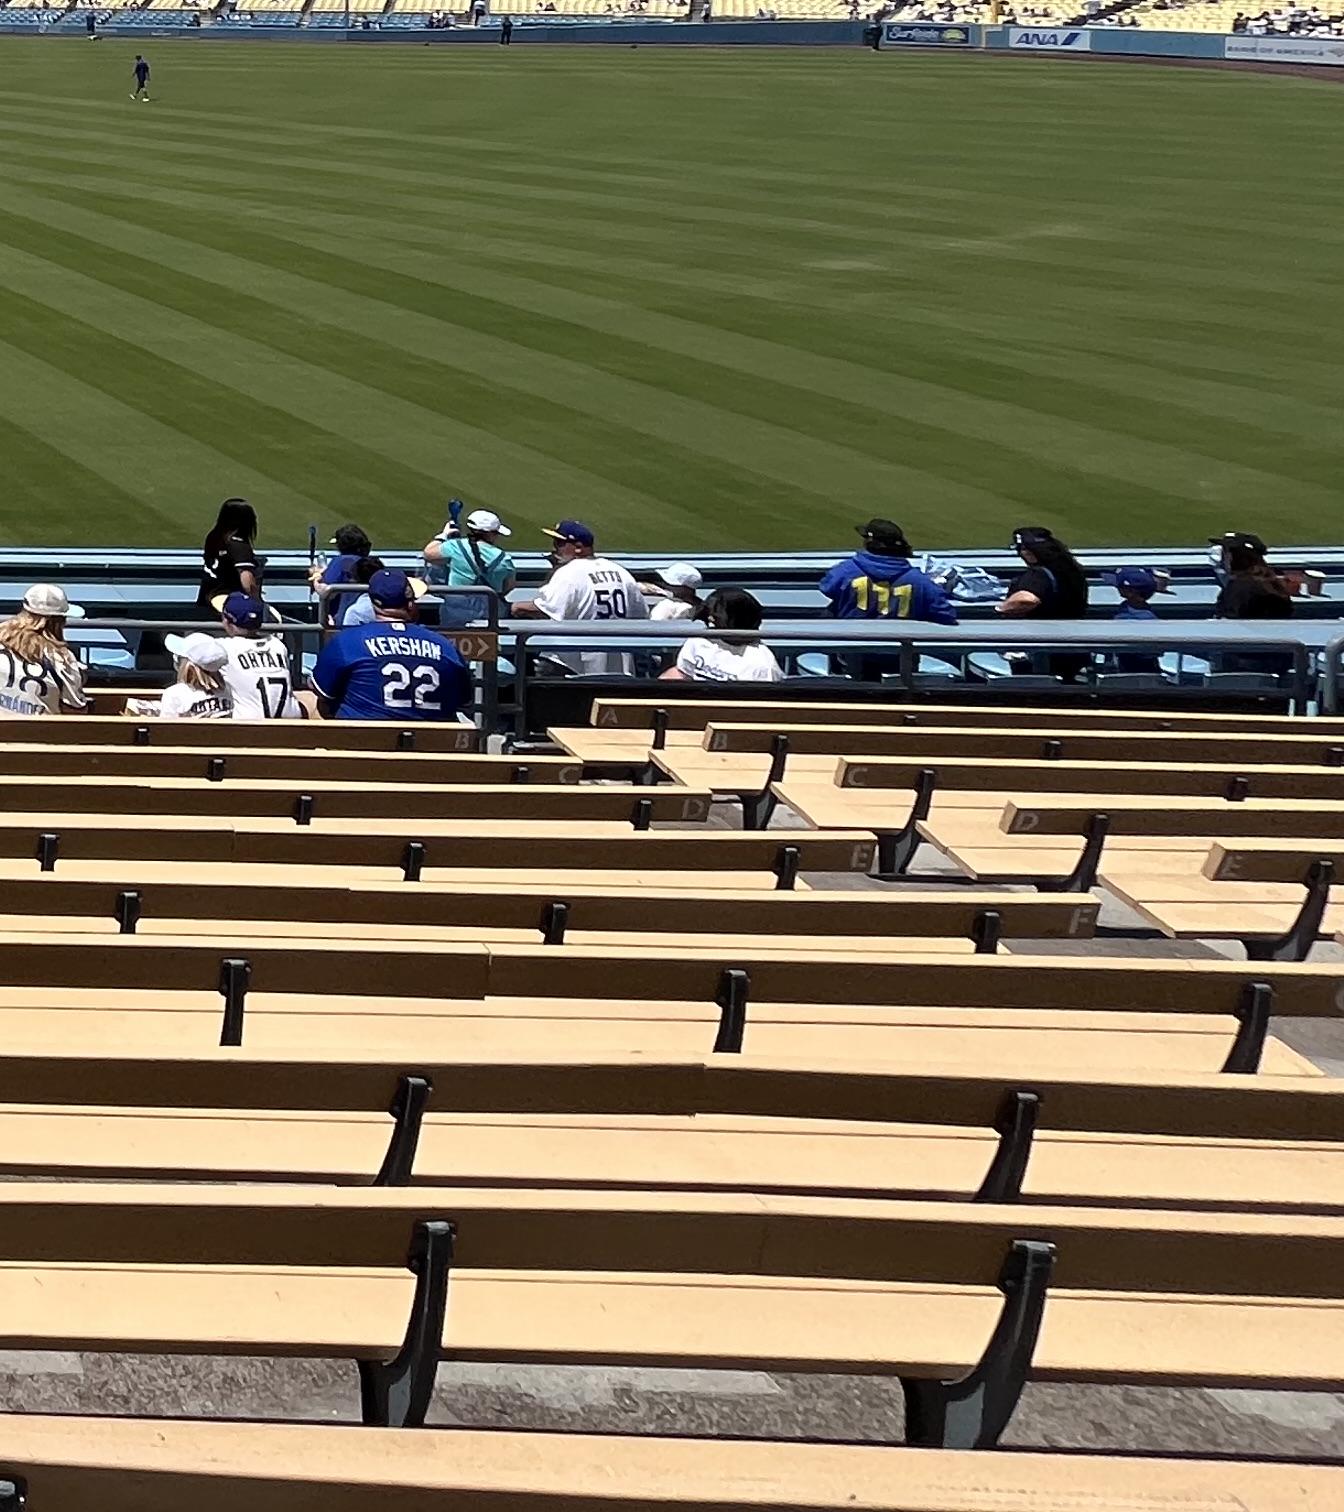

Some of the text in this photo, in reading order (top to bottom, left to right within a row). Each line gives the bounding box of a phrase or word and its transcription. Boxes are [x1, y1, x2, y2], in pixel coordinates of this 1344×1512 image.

[1015, 32, 1059, 46] ANA
[596, 588, 627, 619] 50
[238, 649, 287, 670] OHTAN
[381, 662, 442, 710] 22
[256, 676, 288, 719] 17
[601, 707, 618, 724] A
[455, 732, 470, 749] B
[713, 734, 728, 750] B
[559, 766, 580, 784] C
[847, 768, 869, 786] C
[682, 801, 705, 819] D
[1016, 814, 1040, 830] D
[851, 845, 871, 869] E
[1069, 908, 1093, 934] F
